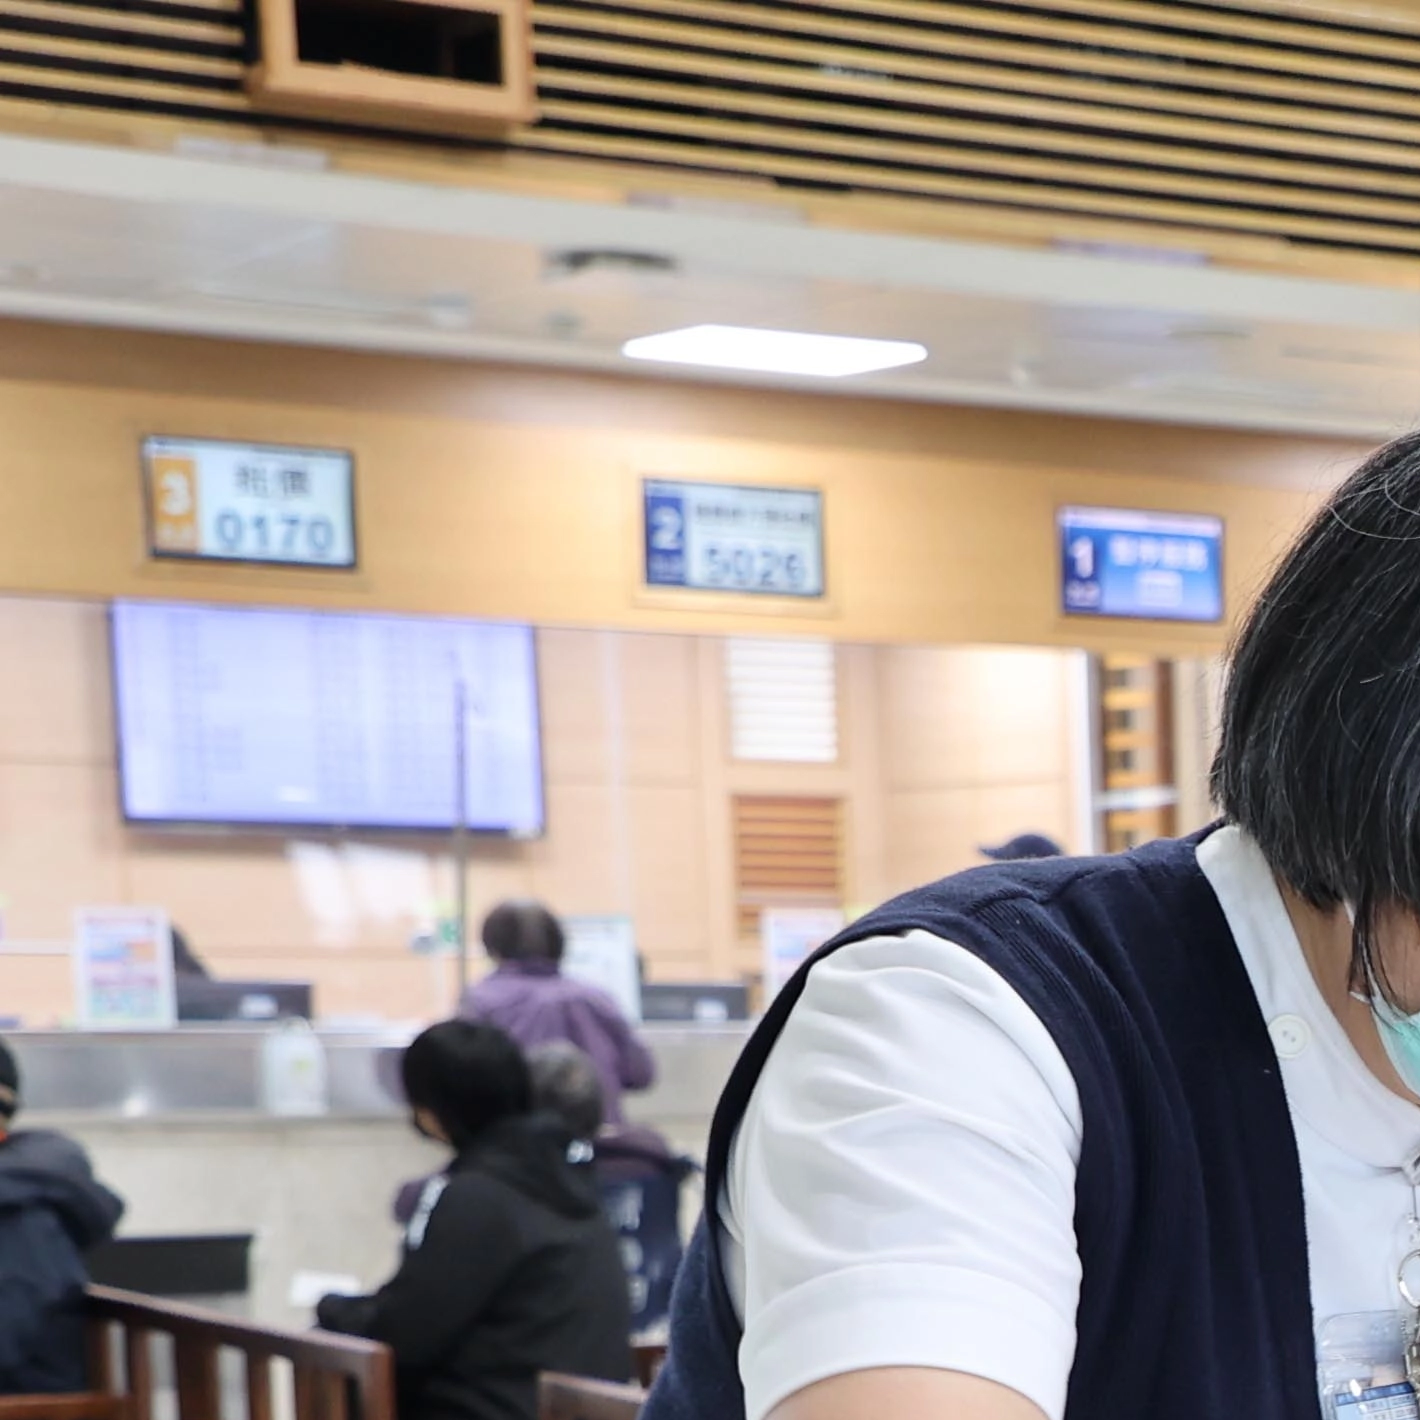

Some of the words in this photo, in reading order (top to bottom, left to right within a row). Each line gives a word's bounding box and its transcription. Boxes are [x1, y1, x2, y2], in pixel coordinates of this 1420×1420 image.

[158, 469, 193, 518] 3
[213, 508, 336, 555] 0170
[651, 505, 684, 550] 2
[1070, 535, 1095, 579] 1
